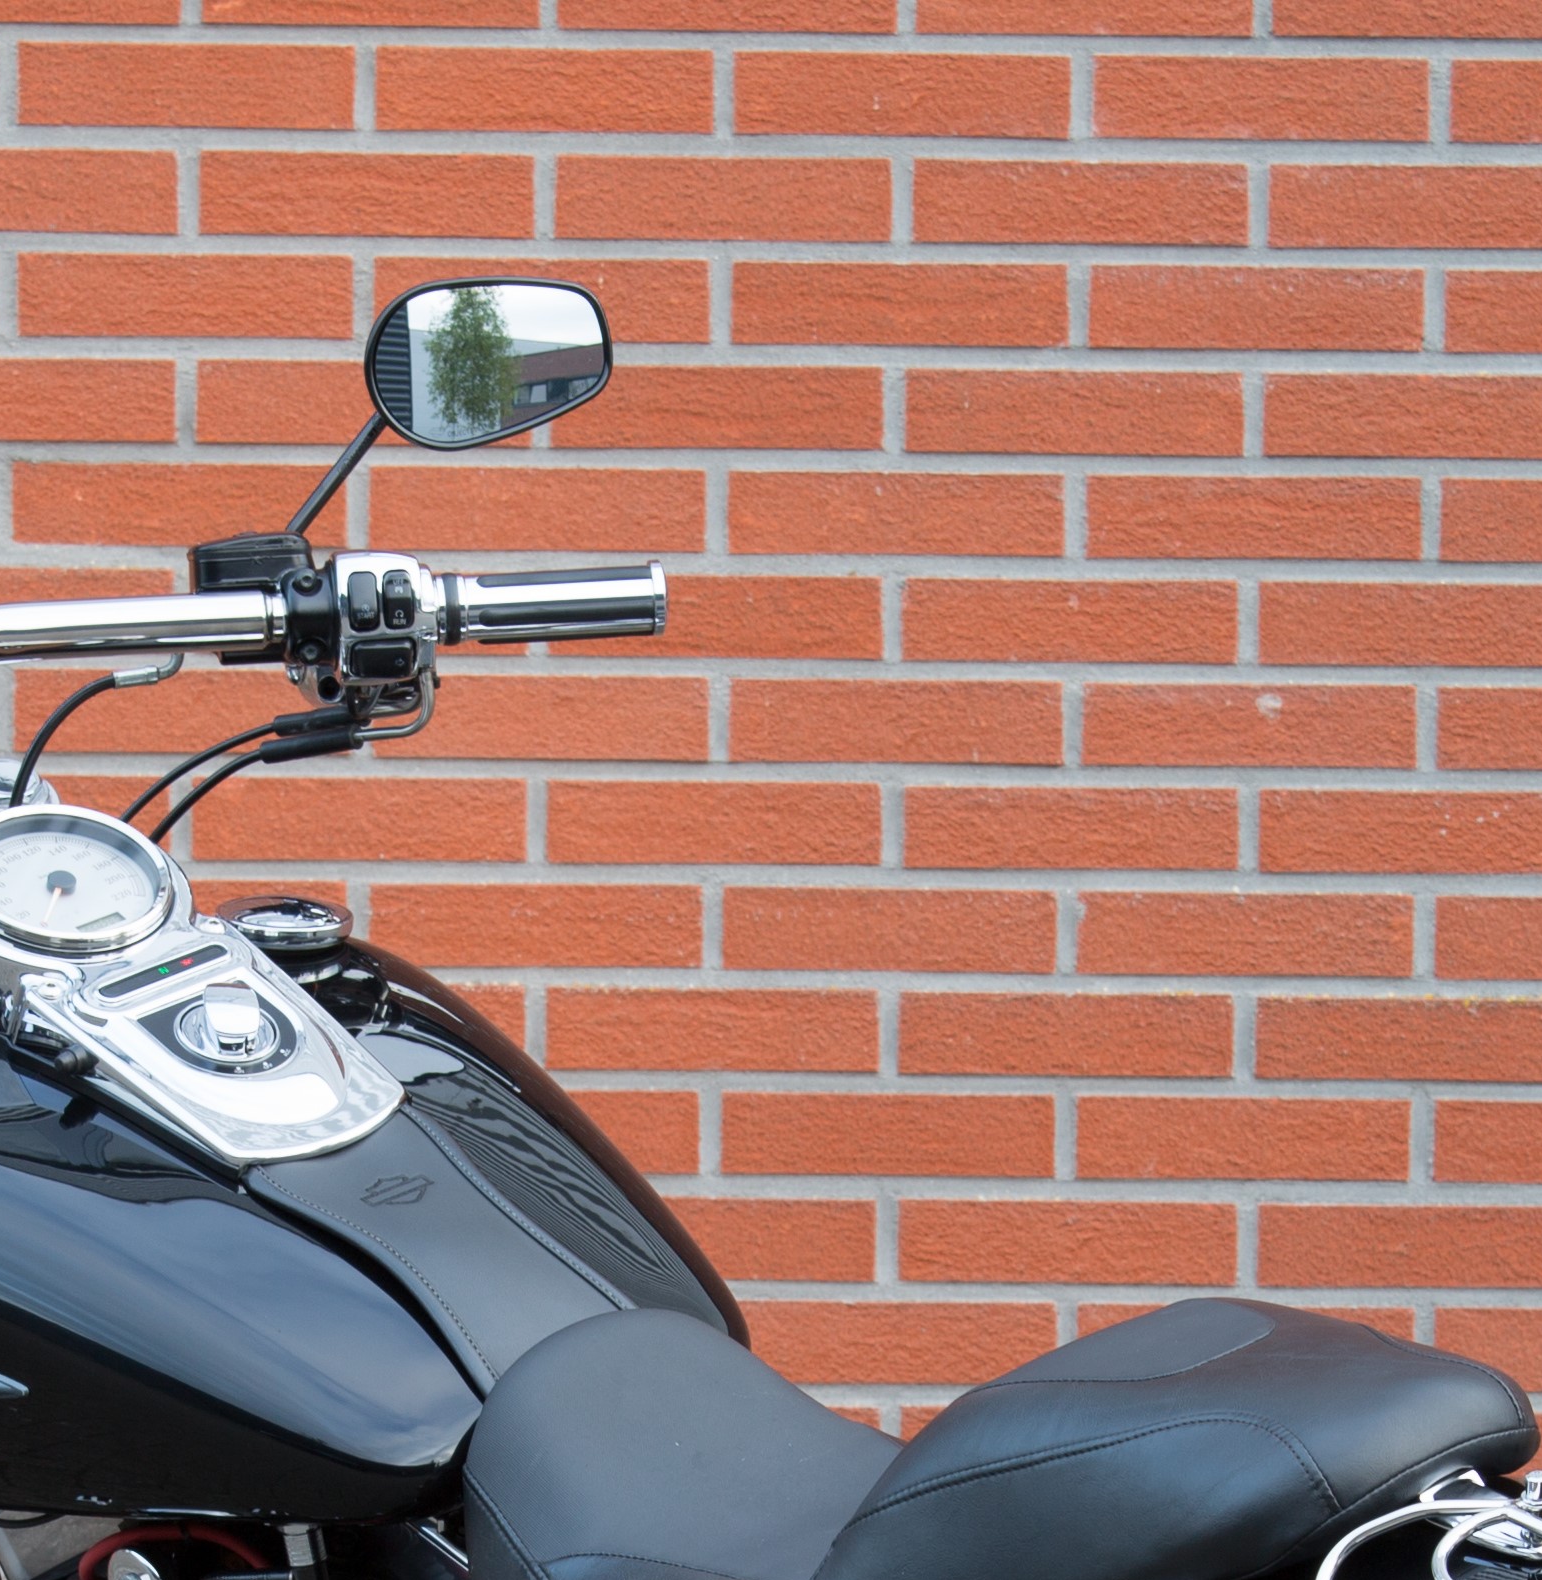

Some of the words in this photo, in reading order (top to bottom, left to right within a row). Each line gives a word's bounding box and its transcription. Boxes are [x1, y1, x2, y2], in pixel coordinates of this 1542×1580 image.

[22, 845, 42, 857] 120
[48, 845, 68, 857] 140
[72, 850, 92, 862] 160
[2, 854, 22, 865] 100
[92, 859, 113, 872] 180
